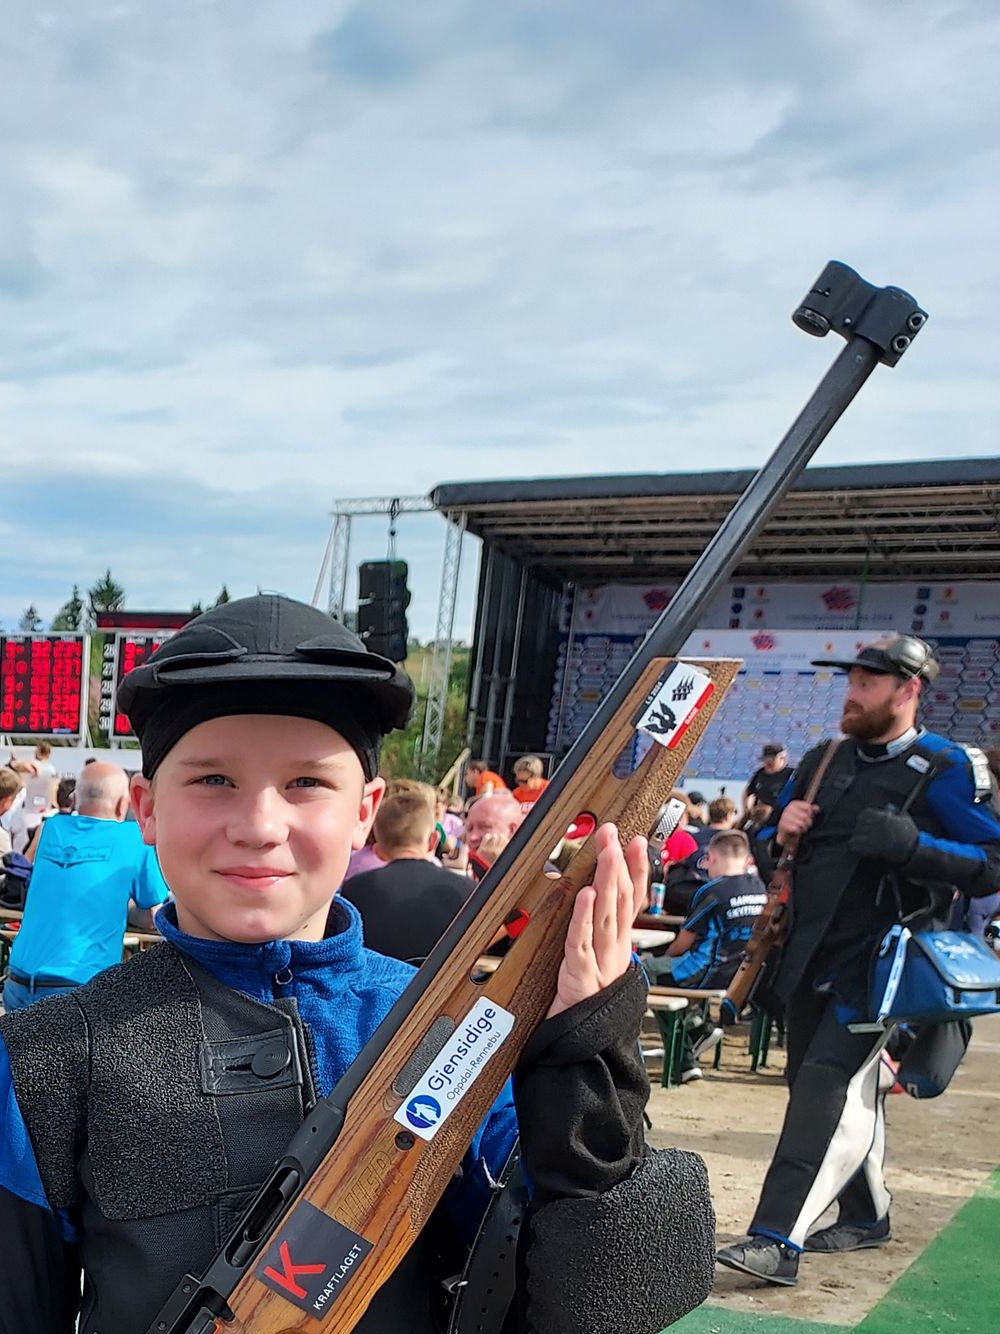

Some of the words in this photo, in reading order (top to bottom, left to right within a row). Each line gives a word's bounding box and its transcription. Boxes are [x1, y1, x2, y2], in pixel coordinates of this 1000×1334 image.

[428, 1008, 497, 1091] Gjensidige
[446, 1030, 502, 1101] Oppdal-Rennebu
[263, 1240, 327, 1300] K
[312, 1243, 363, 1311] KRAFTLAGET
